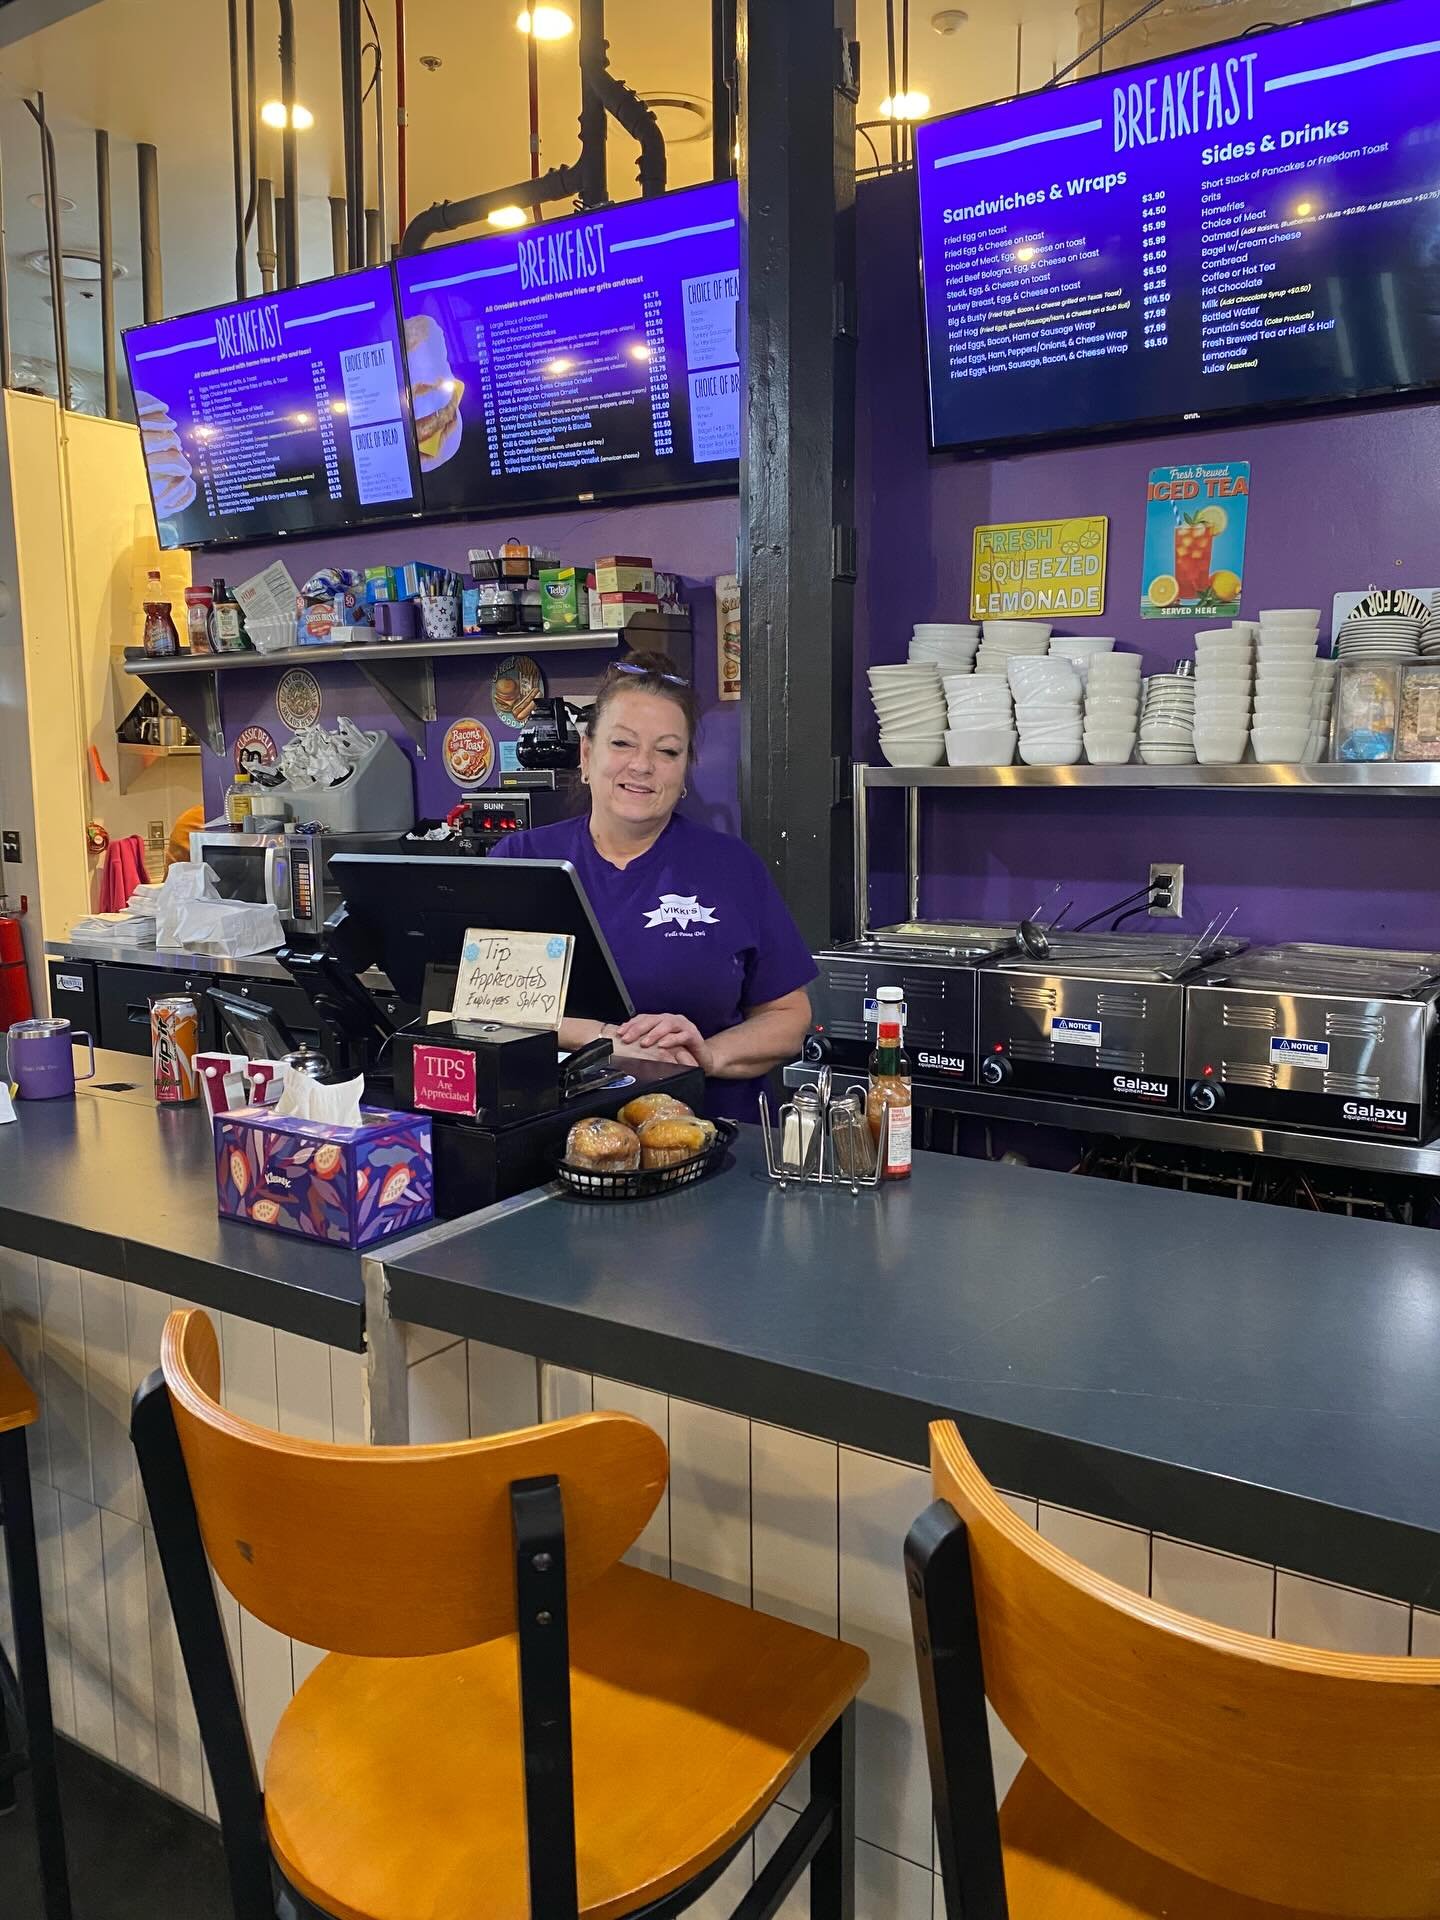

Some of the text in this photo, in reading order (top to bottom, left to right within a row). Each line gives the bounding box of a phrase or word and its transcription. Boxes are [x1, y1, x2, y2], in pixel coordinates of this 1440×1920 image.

[1113, 52, 1258, 152] BREAKFAST
[1202, 120, 1349, 165] Sides & Drinks
[1201, 142, 1388, 189] Short Stack of Pancakes or Freedom Toast
[943, 172, 1126, 223] Sandwiches & Wraps
[1142, 190, 1165, 203] $3.90
[1201, 193, 1221, 202] Grits
[1142, 205, 1166, 218] $4.50
[1201, 201, 1244, 216] Homefries
[1142, 220, 1166, 232] $5.99
[1201, 209, 1266, 229] Choice of Meat
[1142, 235, 1166, 247] $5.99
[1201, 228, 1239, 242] Oatmeal
[944, 248, 962, 258] Fried
[963, 246, 976, 256] Egg
[984, 239, 1012, 250] Cheese
[1013, 236, 1023, 244] on
[1024, 231, 1044, 241] toast
[1201, 231, 1301, 256] Bagel w/cream cheese
[518, 224, 604, 290] BREAKFAST
[1143, 250, 1166, 262] $6.50
[1201, 253, 1247, 269] Cornbread
[1143, 265, 1167, 276] $6.50
[1201, 271, 1230, 282] Coffee
[1242, 265, 1257, 275] Hot
[1259, 263, 1275, 272] Tea
[688, 276, 739, 304] CHOICE OF MEA
[1144, 279, 1166, 291] $8.25
[1201, 278, 1262, 295] Hot Chocolate
[1144, 293, 1170, 305] $10.50
[1202, 299, 1218, 309] Milk
[1235, 293, 1267, 303] Chocolate
[1144, 308, 1166, 320] $7.99
[1202, 306, 1259, 322] Bottled Water
[215, 304, 283, 360] BREAKFAST
[1144, 323, 1166, 334] $7.99
[1202, 322, 1238, 335] Fountain
[1240, 319, 1262, 329] Soda
[1202, 319, 1334, 348] Fresh Brewed Tea or Half & Half
[1144, 337, 1168, 348] $9.50
[345, 348, 386, 372] CHOICE OF MEAT
[950, 368, 967, 378] Fried
[1068, 351, 1075, 359] &
[1076, 348, 1105, 358] Cheese
[1106, 344, 1128, 353] Wrap
[1202, 348, 1247, 361] Lemonade
[1202, 364, 1224, 373] Juice
[694, 376, 717, 398] CHOICE
[720, 375, 728, 395] OF
[1184, 412, 1200, 420] onn.
[1170, 466, 1230, 480] Fresh Brewed
[1148, 476, 1248, 500] ICED TEA
[980, 528, 1052, 553] FRESH
[979, 555, 1099, 584] SQUEEZED
[976, 586, 1100, 613] LEMONADE
[1367, 590, 1391, 616] FOR
[1161, 607, 1191, 615] SERVED
[237, 728, 272, 749] CLASSIC DELI
[463, 740, 485, 751] Toast
[479, 937, 511, 970] Tip
[1068, 1022, 1092, 1030] NOTICE
[1291, 1042, 1318, 1051] NOTICE
[424, 1056, 465, 1080] TIPS
[918, 1053, 964, 1071] Galaxy
[438, 1080, 453, 1089] Are
[1113, 1076, 1168, 1096] Galaxy
[421, 1088, 469, 1101] Appreciated
[1343, 1102, 1407, 1125] Galaxy
[1343, 1114, 1378, 1122] equipment
